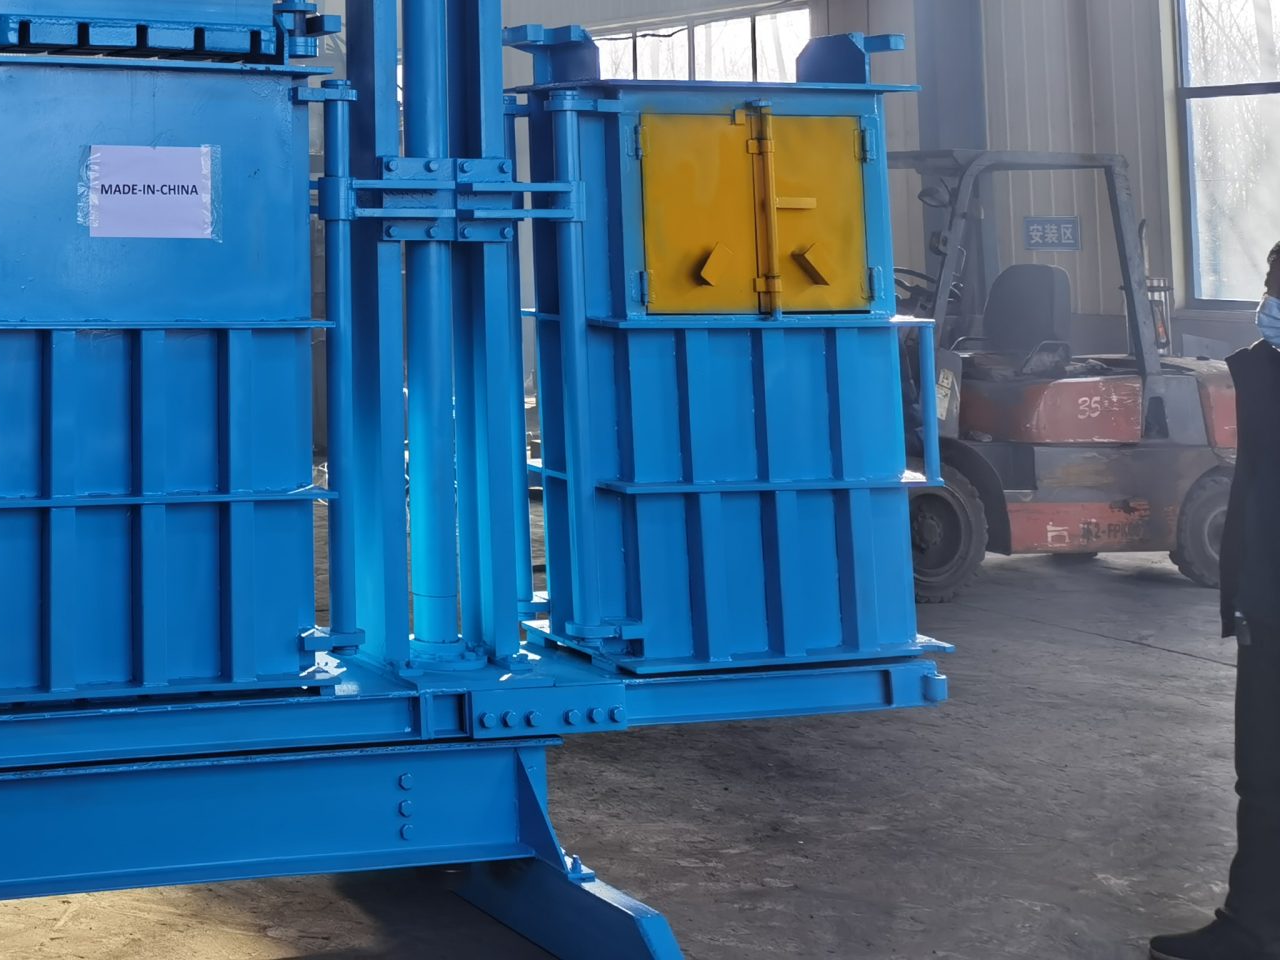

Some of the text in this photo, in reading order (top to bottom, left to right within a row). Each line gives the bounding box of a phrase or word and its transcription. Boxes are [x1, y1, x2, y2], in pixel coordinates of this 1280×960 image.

[101, 184, 199, 196] MADE-IN-CHINA
[1030, 224, 1075, 244] 安装区
[1078, 396, 1100, 419] 35
